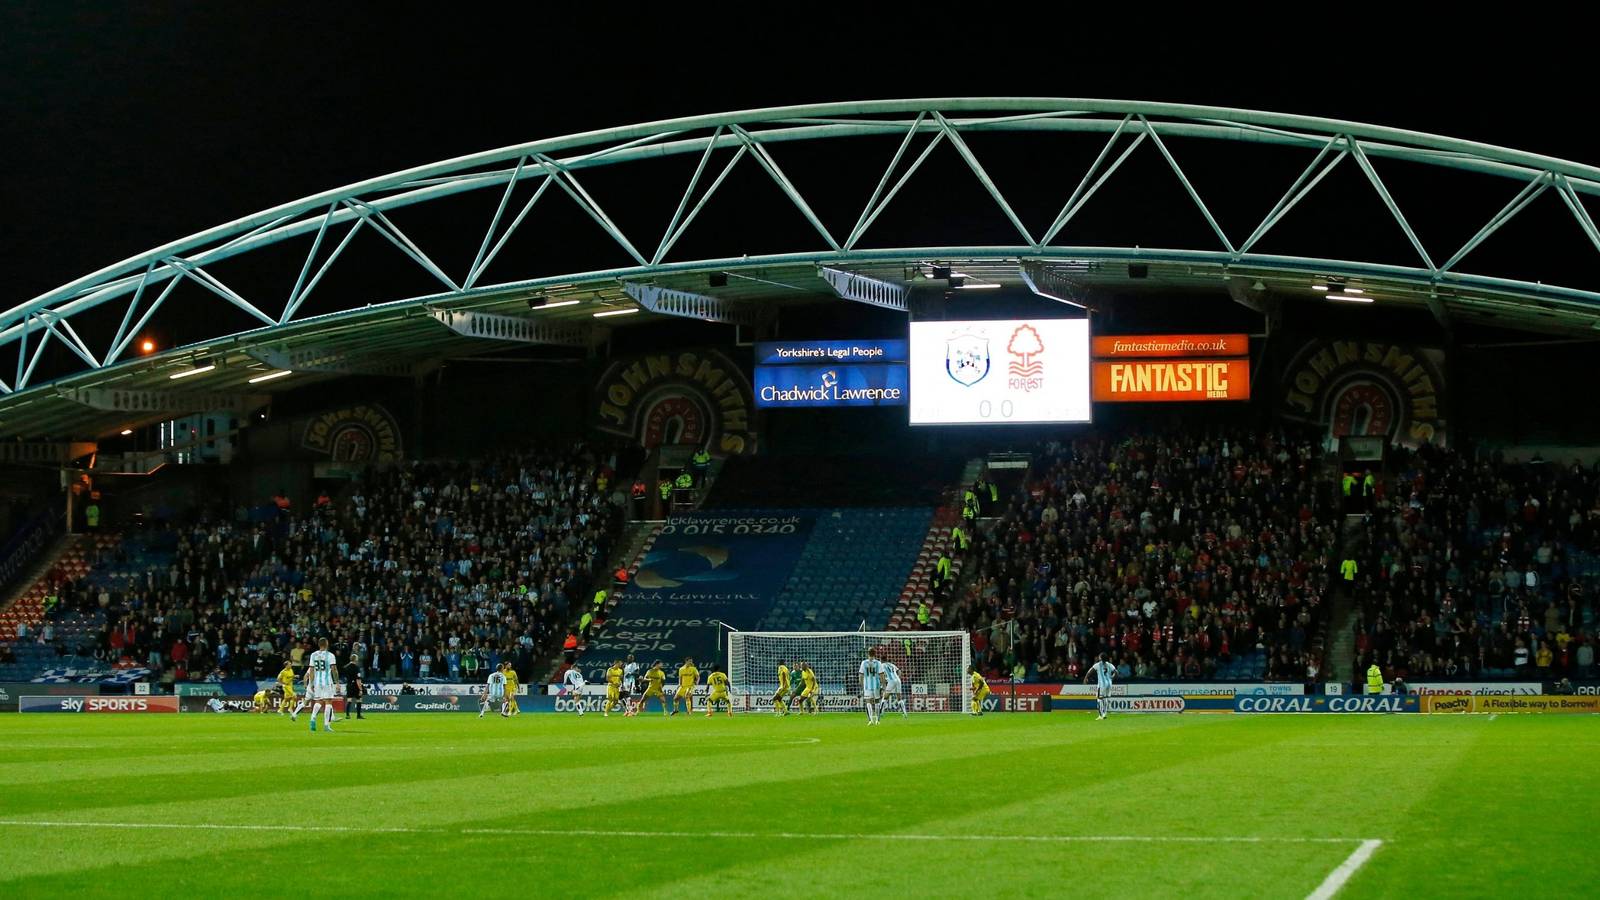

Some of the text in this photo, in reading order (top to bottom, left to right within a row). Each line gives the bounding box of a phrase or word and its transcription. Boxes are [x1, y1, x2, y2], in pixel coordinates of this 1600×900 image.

[776, 346, 882, 359] Yorkshire's Legal People
[1111, 339, 1226, 354] fantasticmedia.co.uk
[1008, 378, 1043, 392] FOREST
[761, 386, 900, 401] Chadwick Lawrence
[599, 629, 673, 641] Legal
[314, 660, 326, 671] 33
[61, 698, 148, 712] sky SPORTS
[361, 703, 400, 711] apitalOne
[555, 696, 622, 712] bookie
[913, 698, 945, 710] BET
[981, 698, 1038, 711] ky BET
[1238, 697, 1313, 711] CORAL
[1329, 697, 1403, 711] CORAL
[1434, 698, 1469, 710] Peachy
[1483, 700, 1490, 708] A
[1492, 700, 1527, 708] Flexible
[1561, 700, 1599, 708] Borrow!
